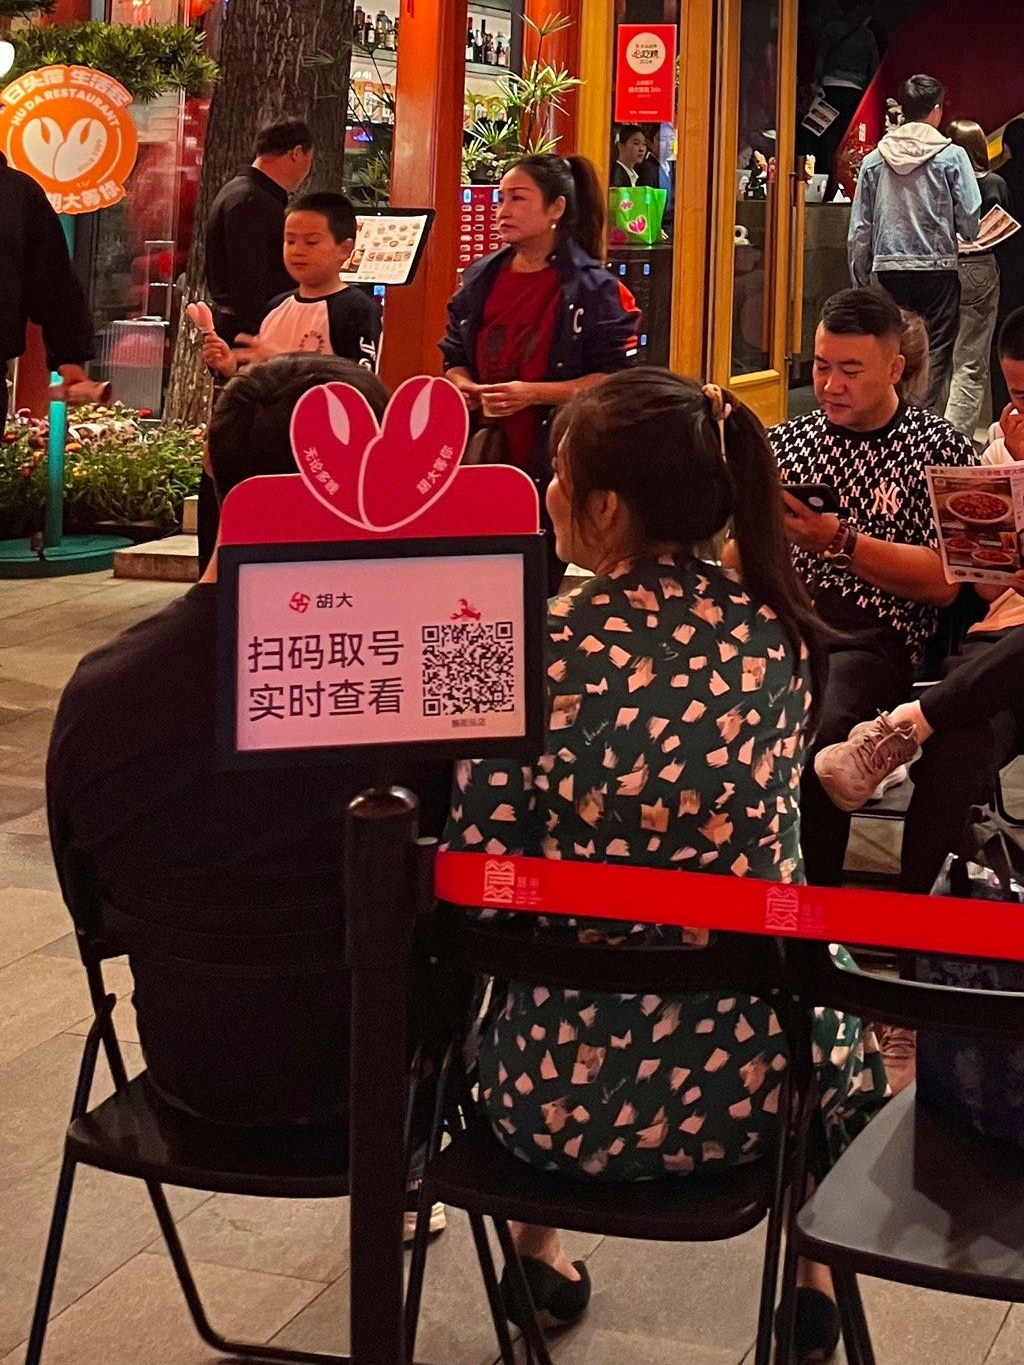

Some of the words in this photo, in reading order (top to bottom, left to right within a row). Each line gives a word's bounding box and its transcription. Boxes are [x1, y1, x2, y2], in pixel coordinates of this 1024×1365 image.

[11, 109, 27, 126] HU
[26, 95, 45, 111] DA
[44, 88, 120, 126] RESTAURANT
[316, 592, 353, 610] 胡大
[248, 630, 404, 673] 扫码取号
[248, 677, 404, 722] 实时查看
